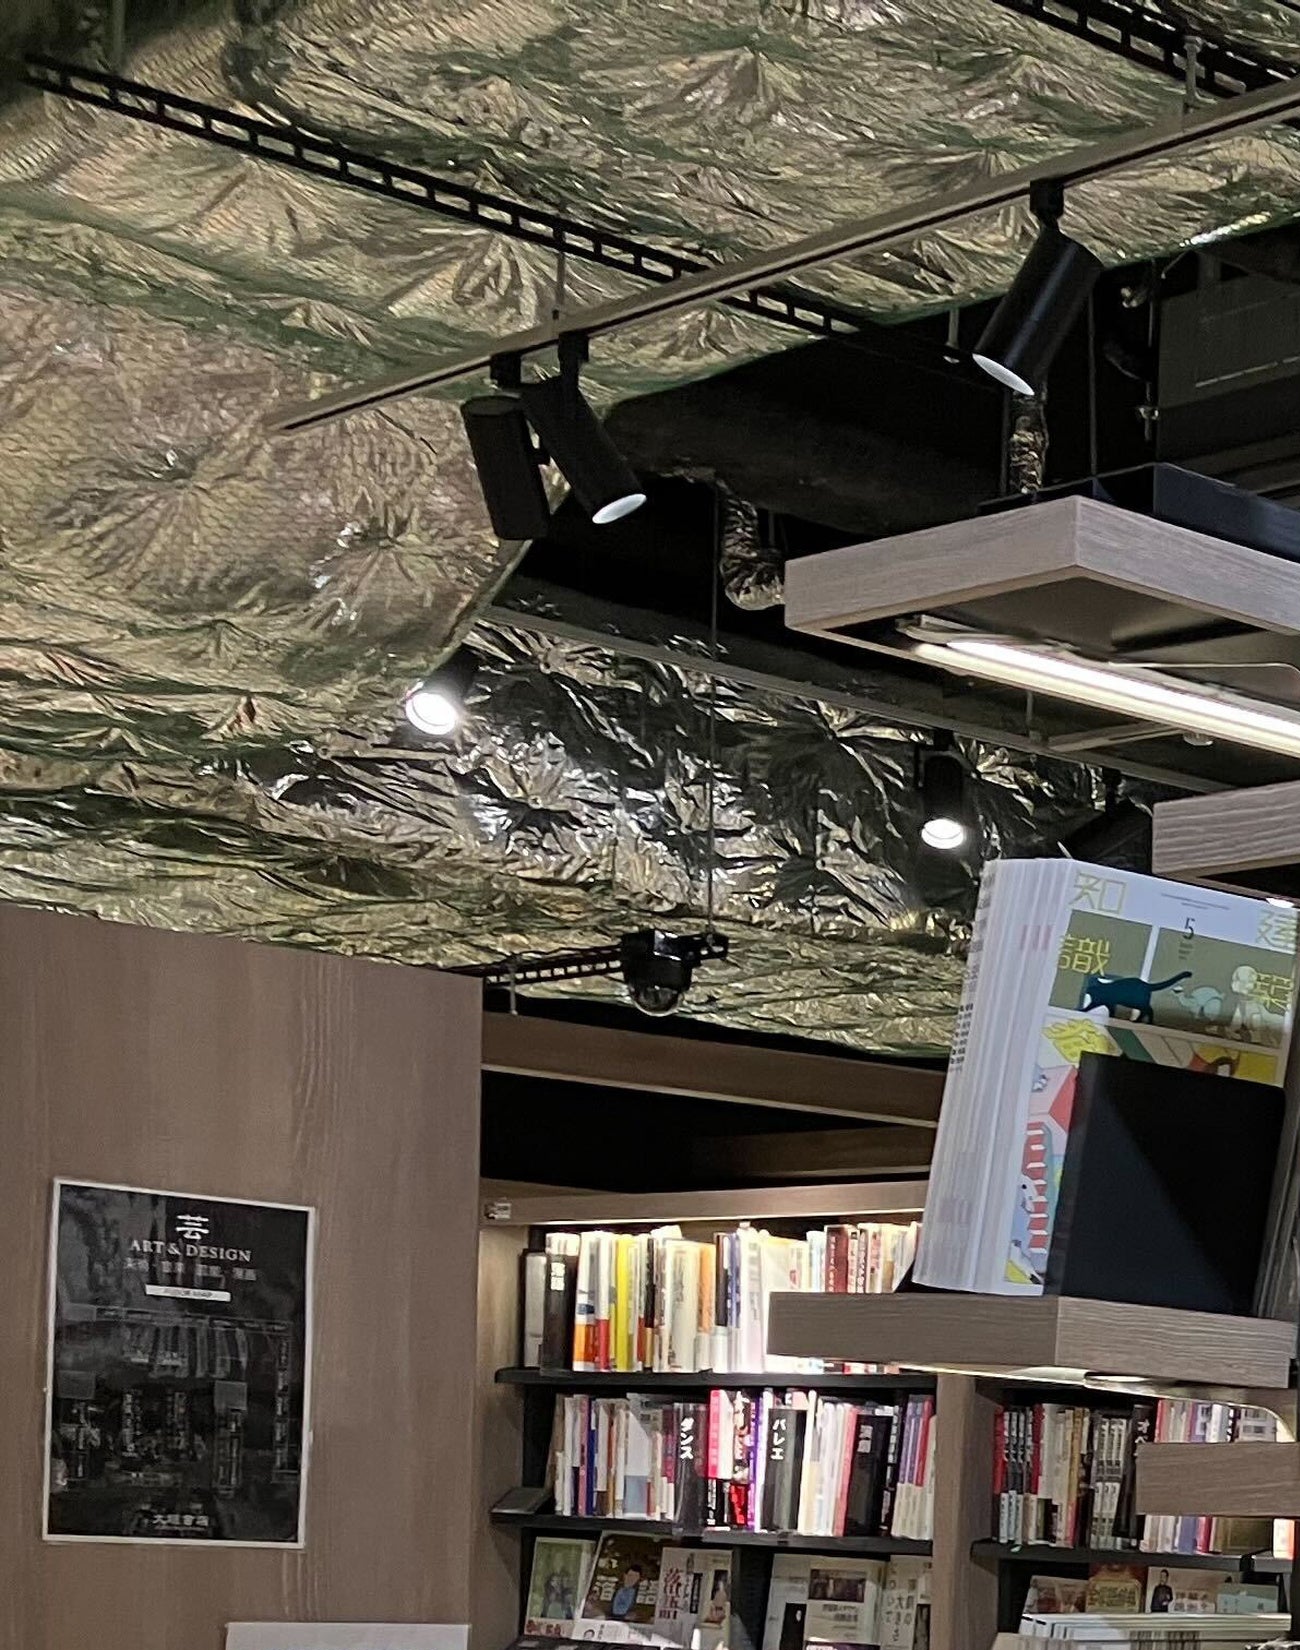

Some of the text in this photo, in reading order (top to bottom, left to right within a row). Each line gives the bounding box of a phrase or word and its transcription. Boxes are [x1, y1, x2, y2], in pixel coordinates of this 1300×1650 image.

[130, 1239, 164, 1254] ART
[186, 1243, 252, 1263] DESIGN
[680, 1416, 694, 1460] ダンス
[771, 1417, 787, 1461] バレエ
